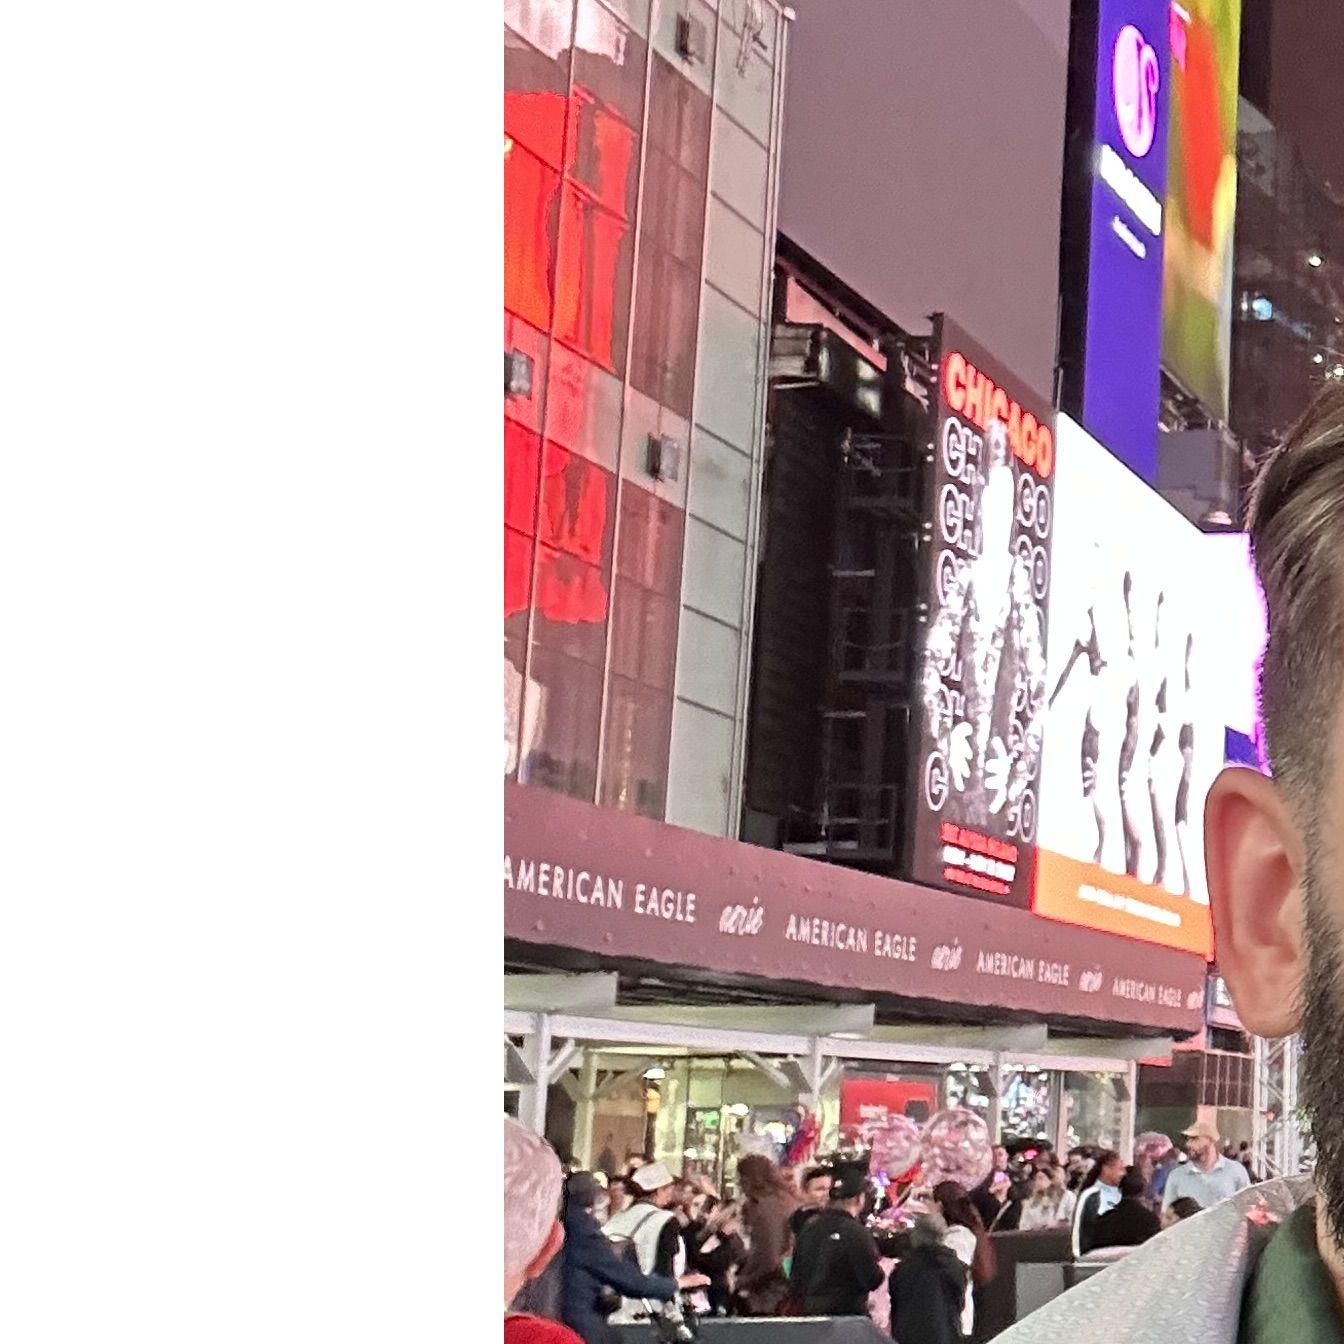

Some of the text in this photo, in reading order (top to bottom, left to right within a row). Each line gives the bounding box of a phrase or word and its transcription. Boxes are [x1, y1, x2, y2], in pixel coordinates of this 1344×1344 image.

[504, 855, 623, 909] AMERICAN
[634, 883, 697, 923] EAGLE
[785, 914, 868, 952] AMERICAN
[874, 929, 917, 962] EAGLE
[976, 950, 1033, 979] AMERICAN
[1038, 961, 1069, 986] EAGLE
